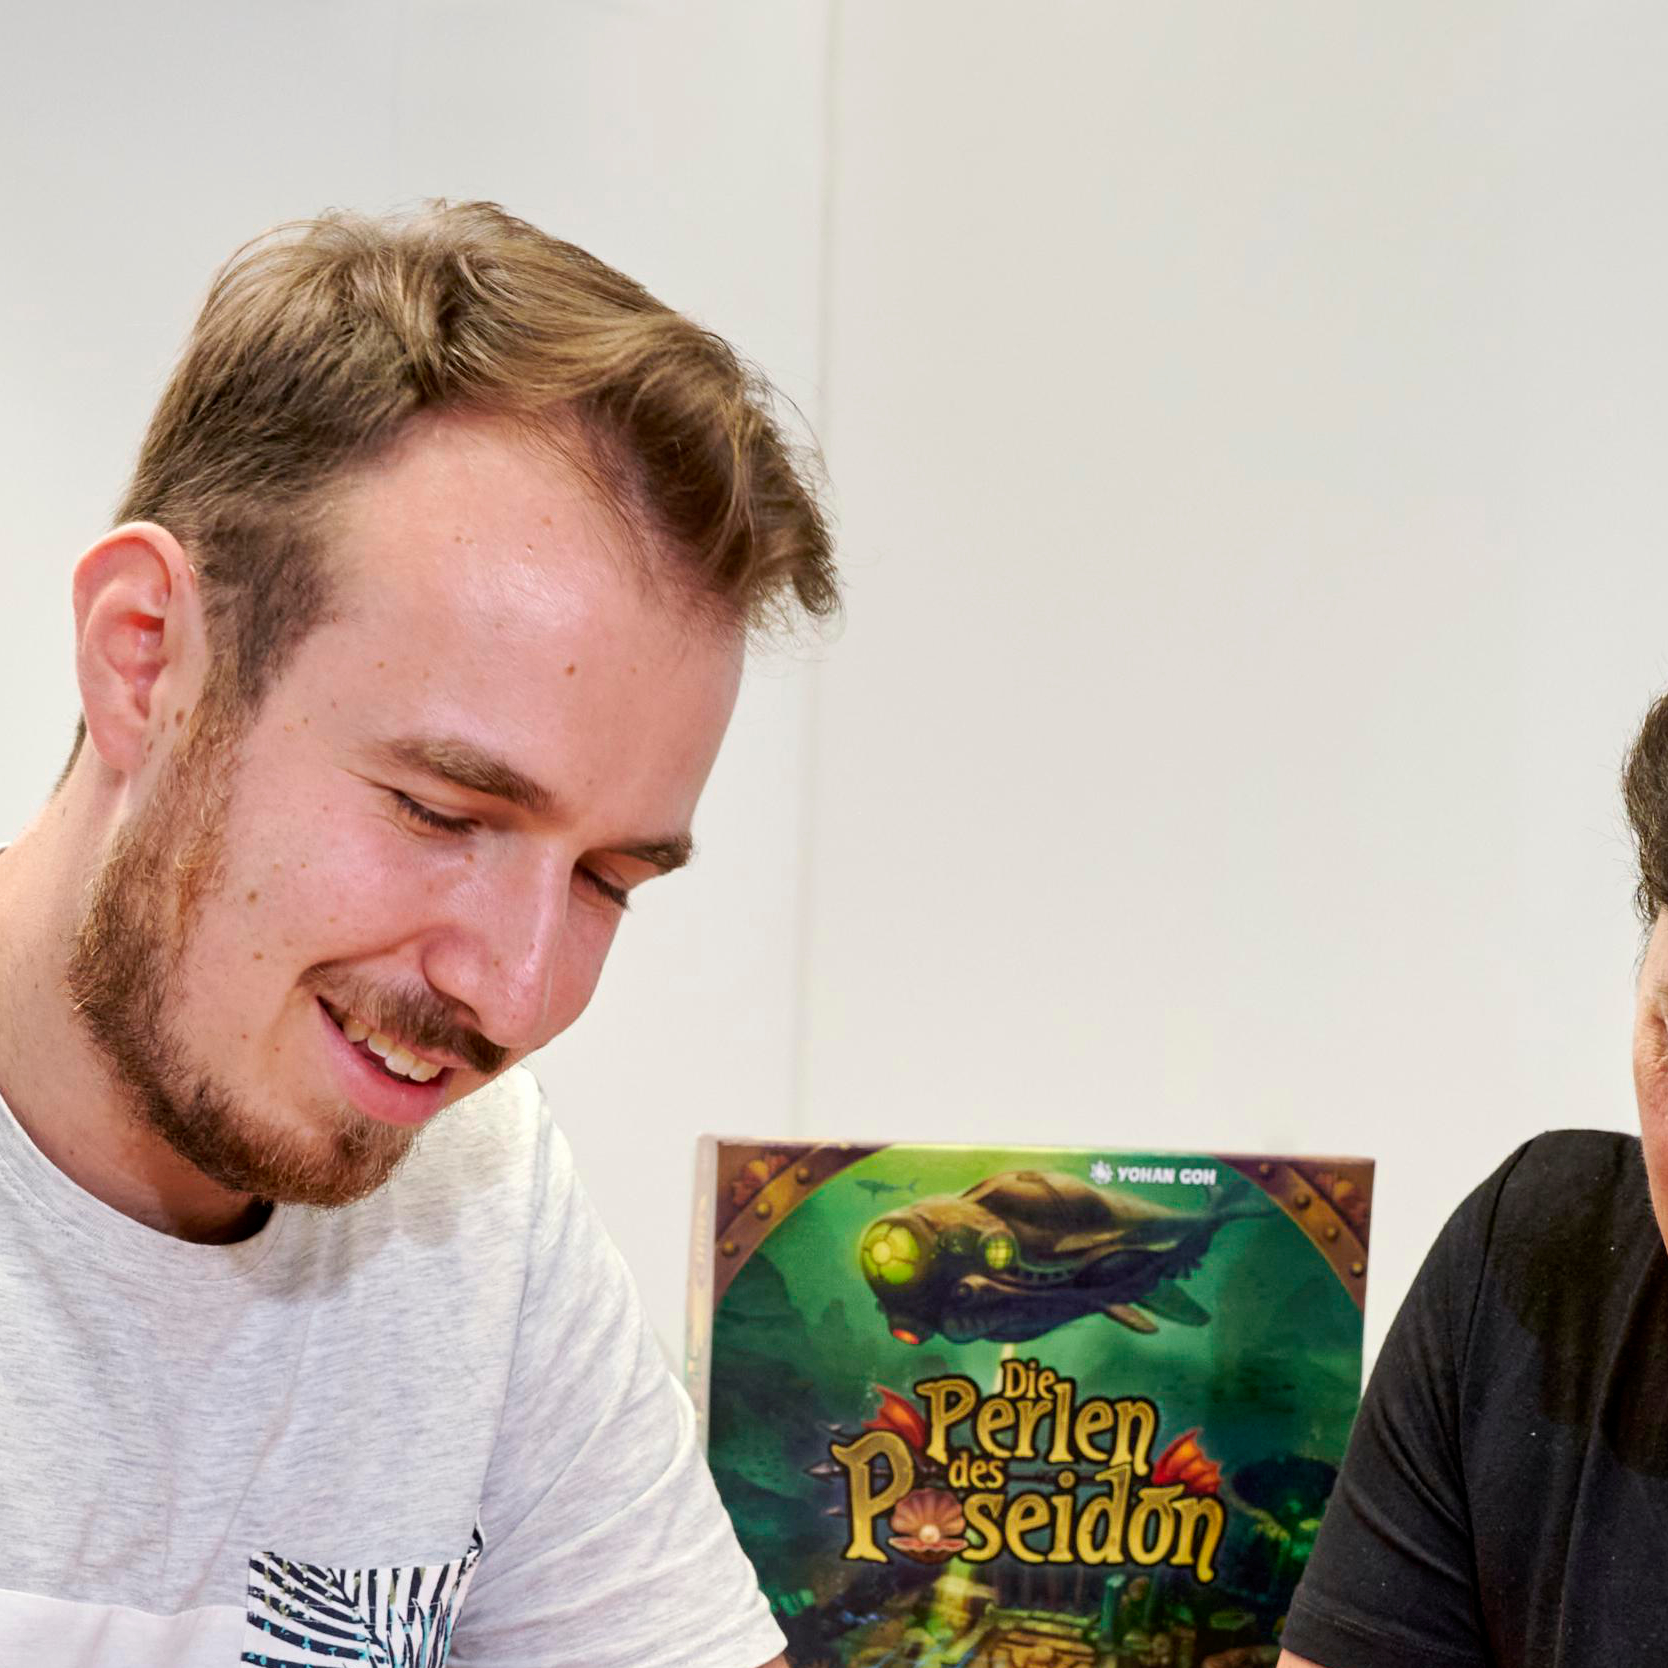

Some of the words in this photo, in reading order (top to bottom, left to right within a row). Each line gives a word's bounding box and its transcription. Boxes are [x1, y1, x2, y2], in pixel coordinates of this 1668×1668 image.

[1117, 1166, 1175, 1184] YOHAN
[1179, 1167, 1217, 1185] GOH
[1003, 1361, 1055, 1398] Die
[916, 1378, 1158, 1474] Perlen
[949, 1452, 1004, 1489] des
